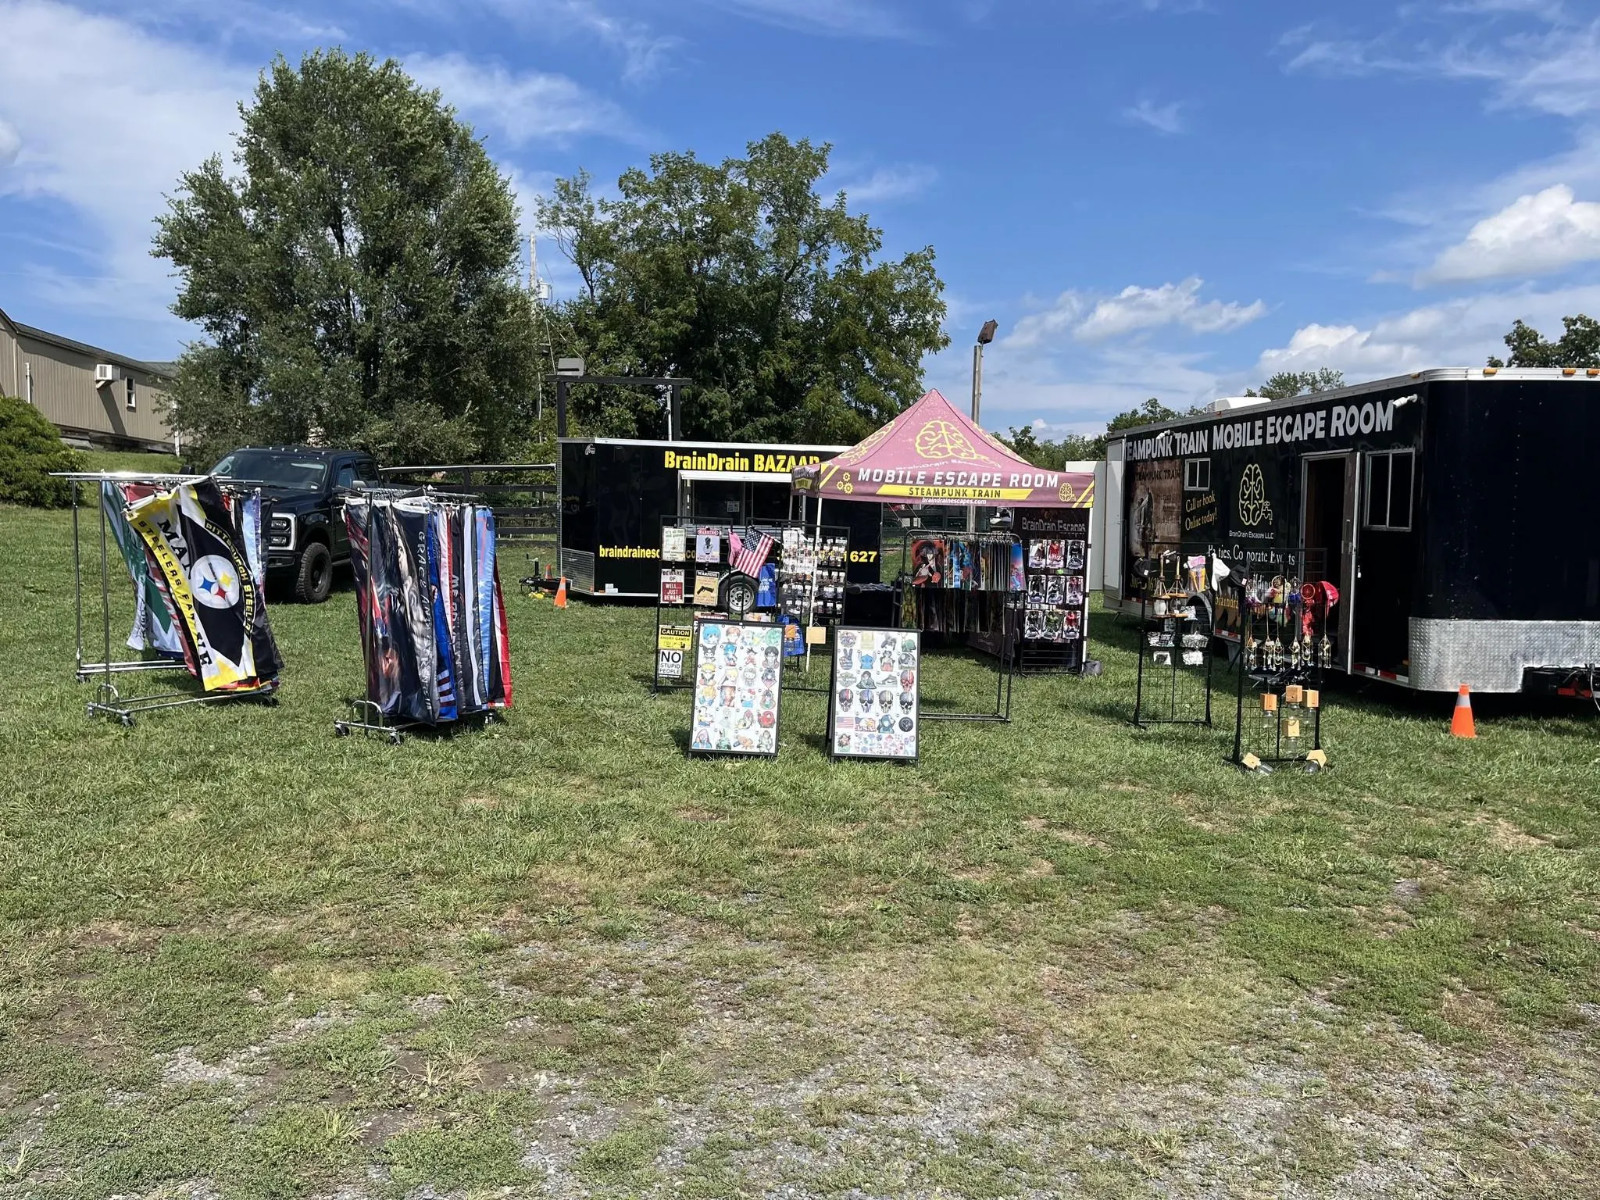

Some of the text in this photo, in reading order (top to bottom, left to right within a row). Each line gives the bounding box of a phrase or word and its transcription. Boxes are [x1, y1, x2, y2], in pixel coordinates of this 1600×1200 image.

[1174, 429, 1209, 456] TRAIN
[1212, 419, 1263, 451] MOBILE
[1266, 410, 1327, 445] ESCAPE
[1330, 399, 1394, 438] ROOM
[664, 450, 749, 471] BrainDrain
[858, 468, 1059, 488] MOBILE ESCAPE ROOM
[908, 487, 1001, 498] STEAMPUNK TRAIN
[1264, 532, 1274, 540] LLC
[138, 520, 182, 587] STEELERS
[1207, 544, 1232, 560] Paties,
[1233, 544, 1268, 564] Coporate
[660, 651, 682, 664] NO
[660, 662, 681, 670] STUPID
